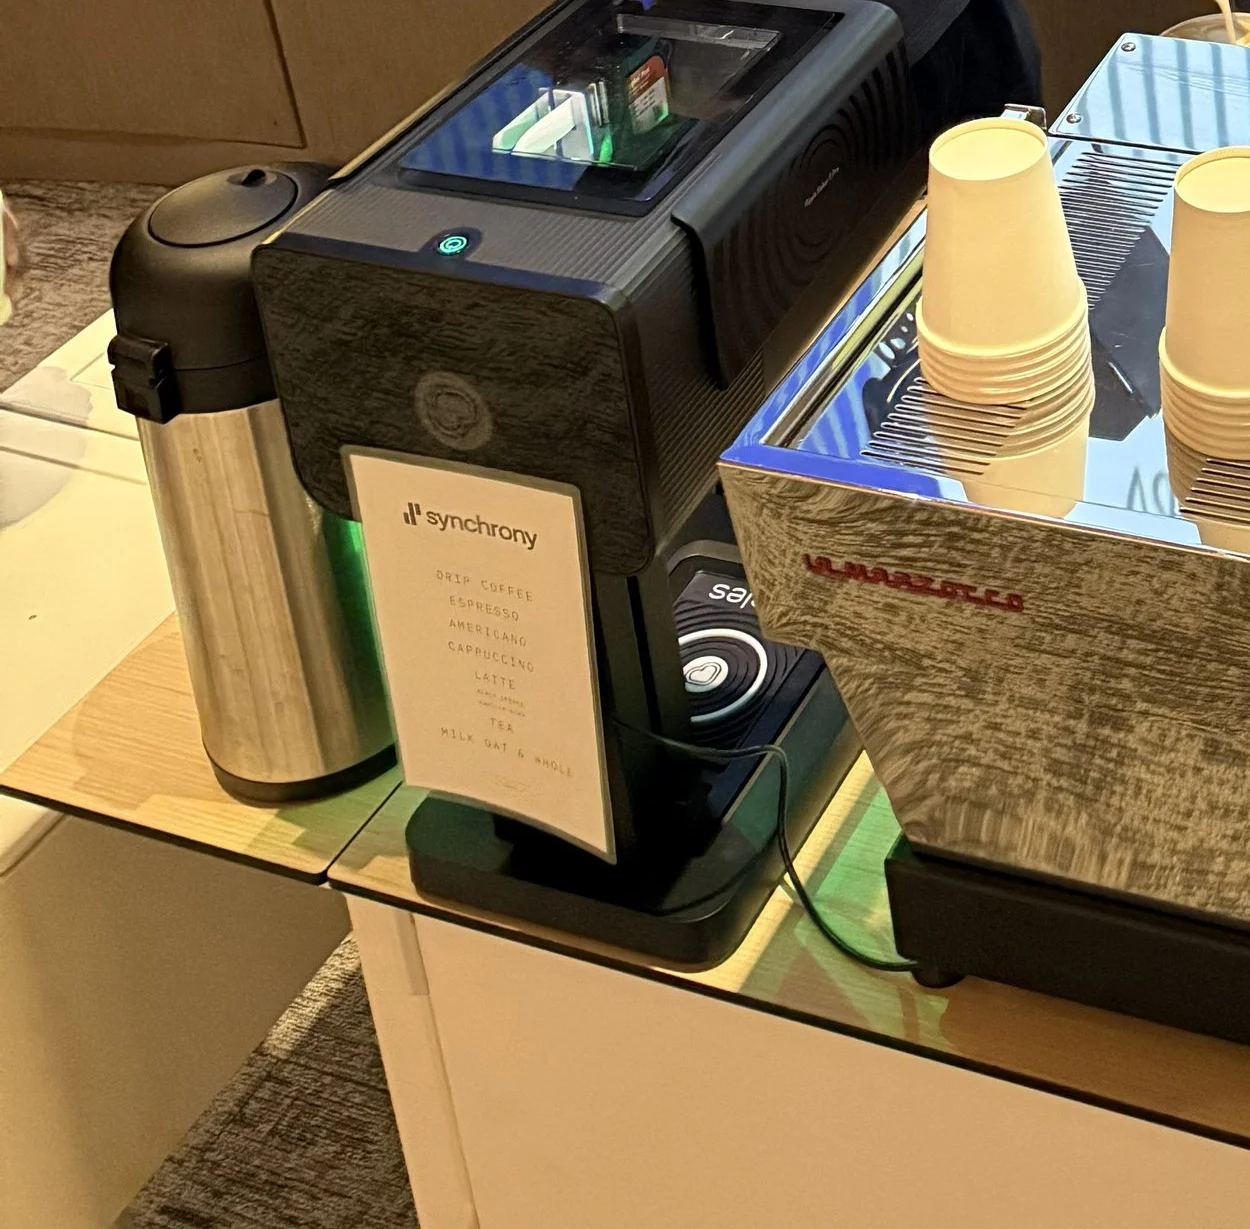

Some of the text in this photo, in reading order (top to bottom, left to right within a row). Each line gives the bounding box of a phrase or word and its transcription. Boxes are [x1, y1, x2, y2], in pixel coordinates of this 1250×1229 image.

[426, 510, 537, 550] synchrony
[436, 570, 533, 602] DRIP COFFEE
[449, 596, 519, 622] ESPRESSO
[449, 619, 527, 647] AMERICANO
[447, 641, 534, 673] CAPPUCCINO
[474, 671, 516, 690] LATTE
[490, 717, 514, 733] TEA
[441, 727, 473, 741] MILK
[484, 738, 508, 753] OAT
[535, 756, 573, 777] WHOLE
